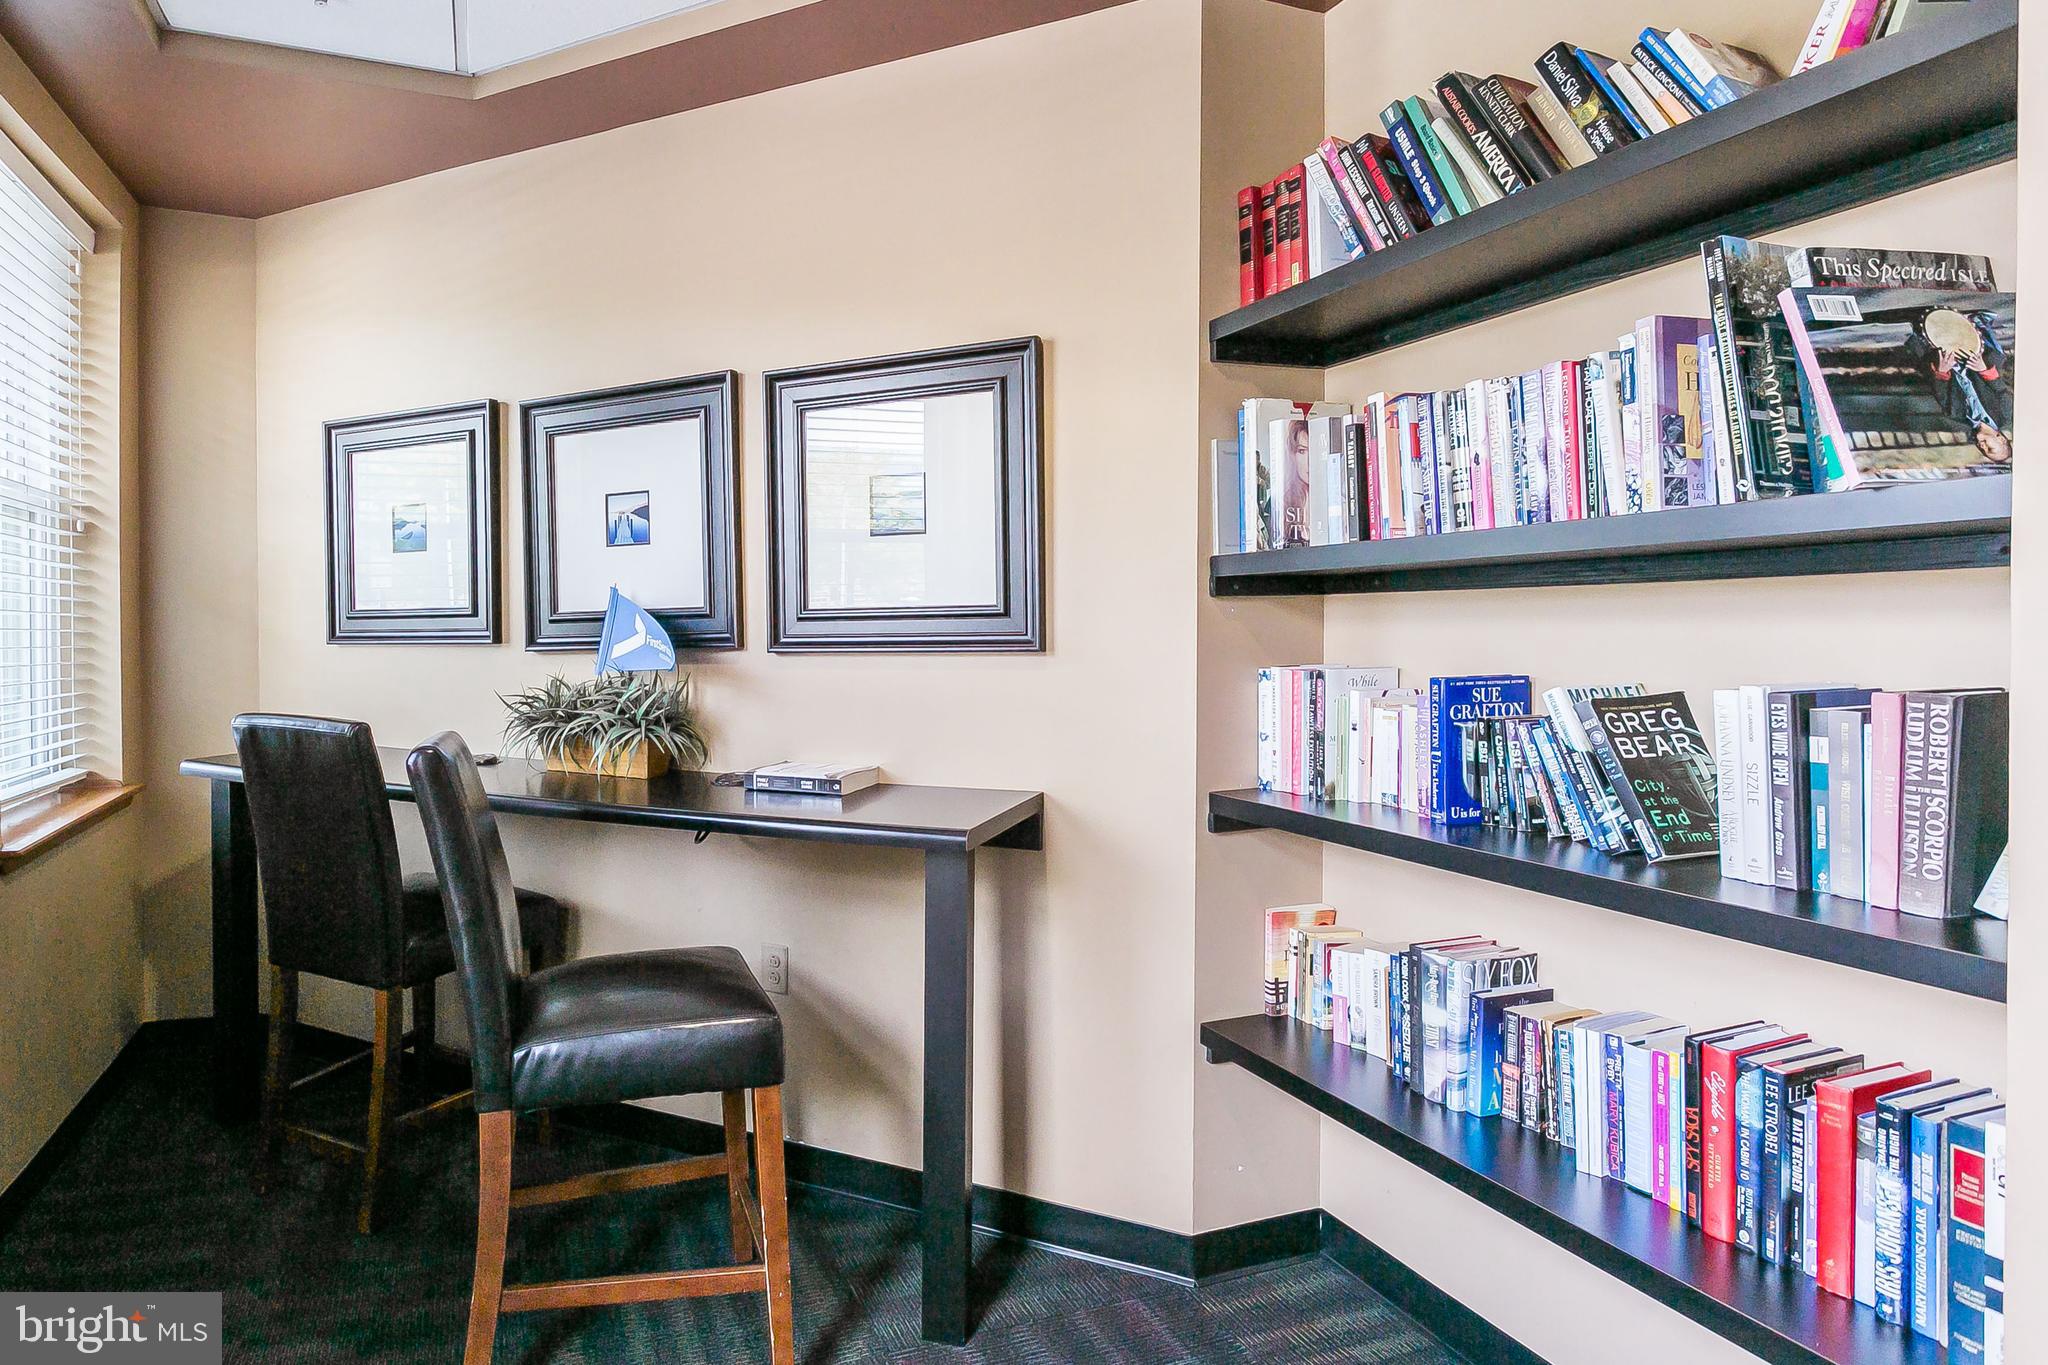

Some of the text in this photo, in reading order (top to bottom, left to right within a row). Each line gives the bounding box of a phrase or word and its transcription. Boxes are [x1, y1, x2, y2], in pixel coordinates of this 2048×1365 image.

[1543, 51, 1582, 108] Daniel Silva
[1634, 47, 1656, 73] PATRICK
[1654, 68, 1682, 101] LENCIONI
[1499, 114, 1517, 139] CLARK
[1591, 132, 1606, 152] Spies
[1596, 119, 1614, 143] House
[1395, 127, 1415, 160] USMLE
[1472, 130, 1517, 192] AMERICA
[1389, 201, 1409, 235] UNSEEN
[1813, 256, 1862, 278] This
[1866, 257, 1947, 283] Spectred
[1713, 293, 1723, 308] THE
[1715, 308, 1726, 331] MOST
[1560, 369, 1569, 416] LENCIONI
[1583, 391, 1593, 424] HOAG
[1585, 431, 1595, 470] DEEPER
[1642, 416, 1652, 454] Histology
[1346, 440, 1355, 468] TARGET
[1514, 472, 1522, 509] TRAILS
[1563, 451, 1574, 507] ADVANTAGE
[1588, 482, 1596, 505] DEAD
[1347, 673, 1378, 688] While
[1472, 687, 1502, 702] SUE
[1450, 702, 1525, 721] GRAFTON
[1604, 708, 1683, 734] GREG
[1614, 733, 1696, 759] BEAR
[1771, 703, 1789, 786] EYES WIDE OPEN
[1905, 701, 1925, 786] LUDLUM
[1927, 703, 1950, 788] ROBERT
[1634, 778, 1665, 793] City
[1719, 759, 1735, 803] LINDSEY
[1746, 762, 1759, 807] SIZZLE
[1451, 806, 1481, 819] U is for
[1644, 795, 1680, 807] at the
[1650, 809, 1692, 828] End
[1773, 796, 1784, 856] Andrew Gross
[1662, 829, 1713, 844] of Time
[1903, 794, 1922, 879] ILLUSION
[1922, 795, 1947, 881] SCORPIO
[1500, 955, 1537, 987] FOX
[1401, 956, 1411, 1064] ROBIN COOK SEIZURE
[1614, 1053, 1624, 1091] PRETTY
[1765, 1076, 1777, 1100] LEE
[1704, 1070, 1727, 1121] Eligible
[1788, 1084, 1808, 1104] LEE
[1606, 1091, 1619, 1171] MARY KUBICA
[1740, 1127, 1749, 1138] IN
[1764, 1100, 1777, 1154] STROBEL
[1791, 1118, 1802, 1144] DATE
[1740, 1139, 1749, 1166] CABIN
[1713, 1154, 1721, 1184] CURTIS
[1740, 1169, 1749, 1180] 10
[1915, 1206, 1926, 1326] MARY HIGGINS CLARK
[1875, 1265, 1900, 1301] IRIS
